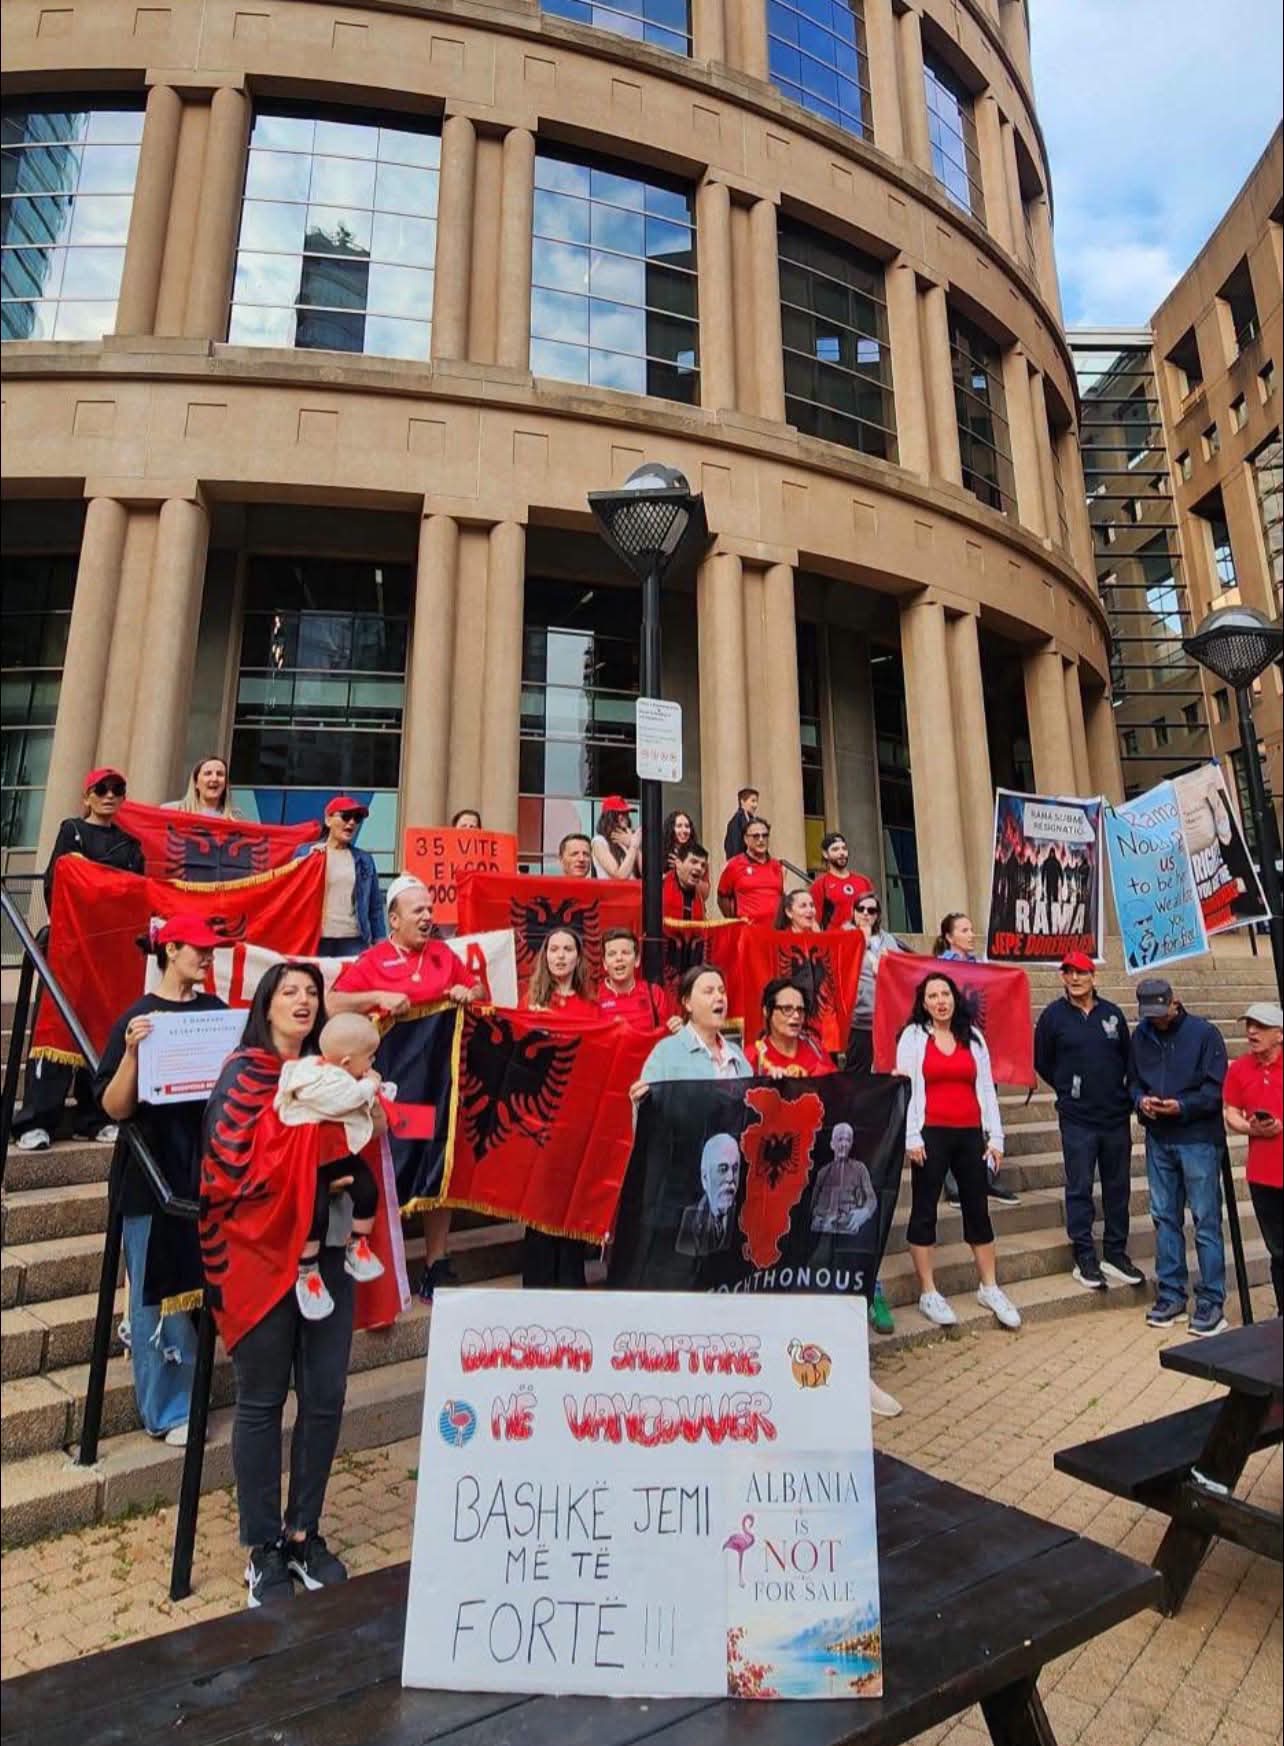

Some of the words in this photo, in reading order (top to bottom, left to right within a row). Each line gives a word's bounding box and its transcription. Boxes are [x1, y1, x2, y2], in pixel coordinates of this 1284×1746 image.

[416, 837, 445, 856] 35
[458, 839, 499, 857] VITE
[1159, 855, 1176, 872] us
[1127, 876, 1151, 896] to
[1015, 898, 1086, 935] RAMA
[460, 1323, 593, 1374] DIASPORA
[491, 1384, 538, 1440] NË
[563, 1391, 777, 1447] VANCOUVER
[745, 1471, 860, 1503] ALBANIA
[453, 1474, 612, 1542] BASHKË
[632, 1484, 710, 1537] JEMI
[794, 1518, 809, 1535] IS
[505, 1544, 549, 1584] MË
[571, 1541, 611, 1580] TË
[764, 1538, 842, 1574] NOT
[755, 1581, 796, 1601] FOR
[805, 1581, 856, 1602] SALE
[452, 1596, 627, 1669] FORTË
